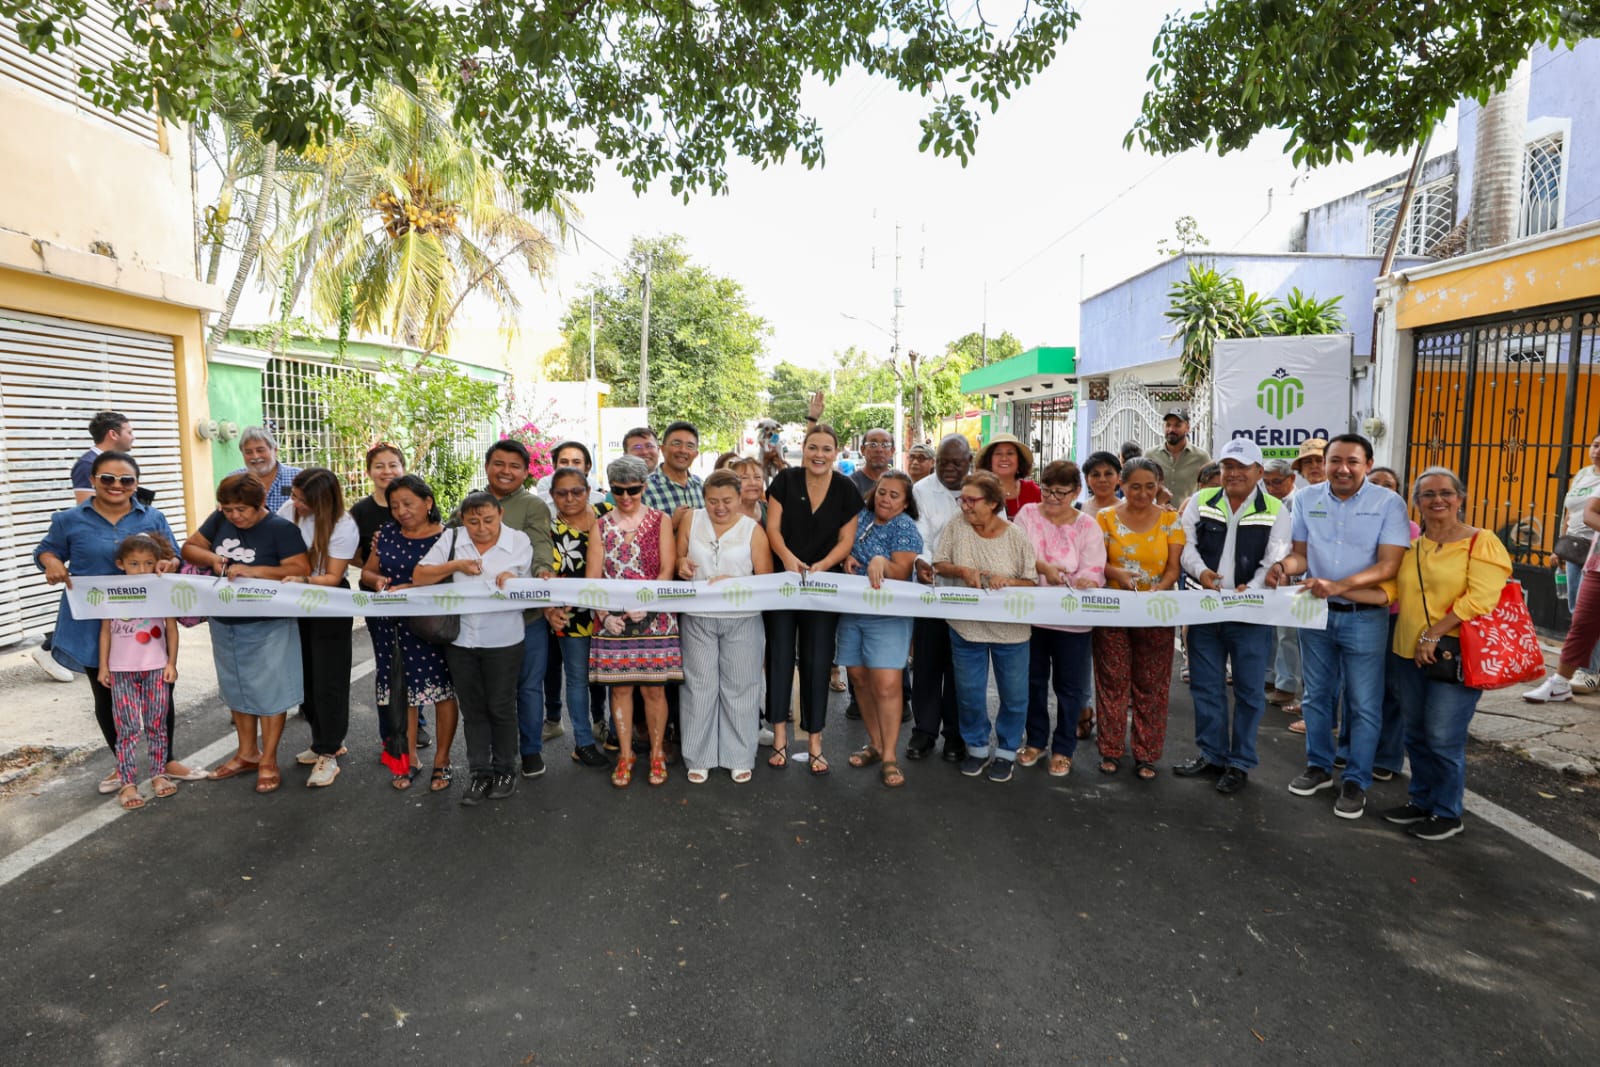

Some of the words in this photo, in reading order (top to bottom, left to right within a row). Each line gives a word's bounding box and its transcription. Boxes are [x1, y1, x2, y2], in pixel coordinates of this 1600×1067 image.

[107, 586, 147, 596] MÉRIDA
[237, 587, 277, 596] MÉRIDA
[510, 590, 551, 600] MÉRIDA
[1081, 595, 1120, 605] MÉRIDA
